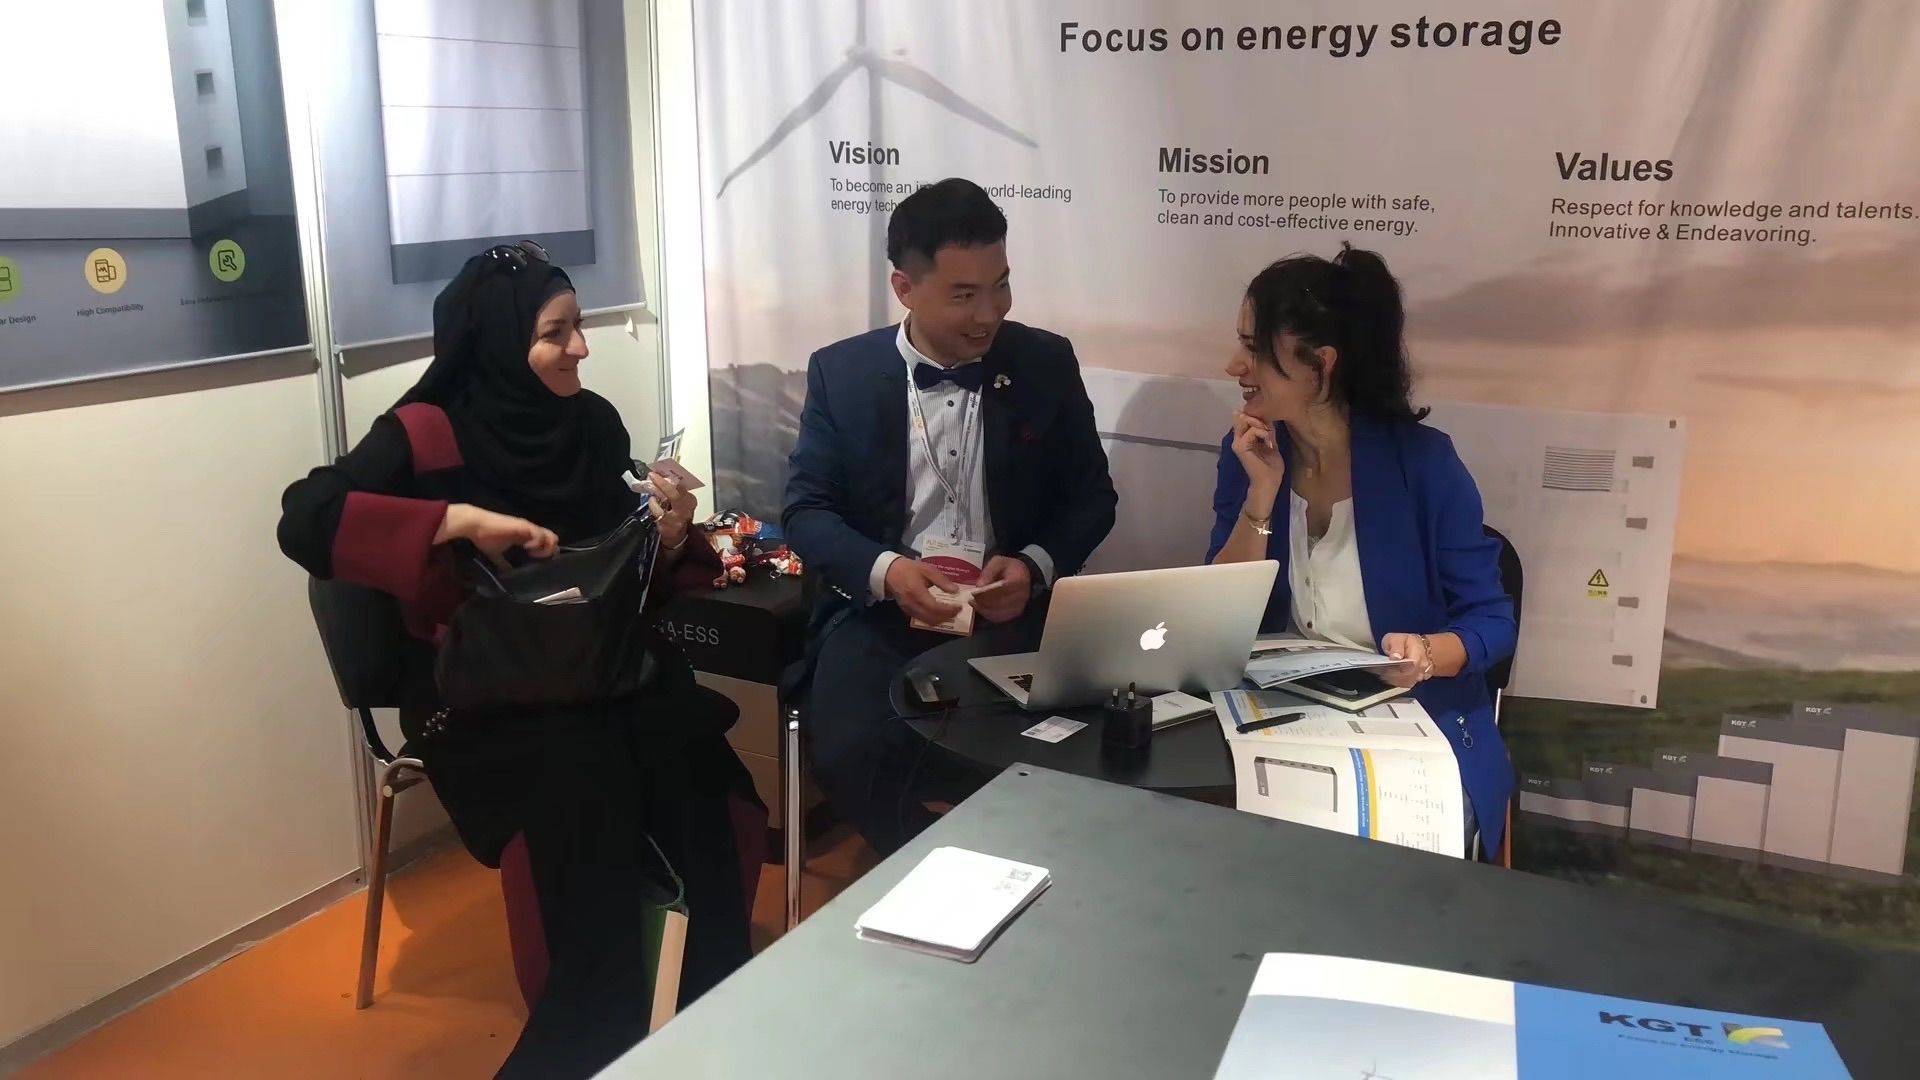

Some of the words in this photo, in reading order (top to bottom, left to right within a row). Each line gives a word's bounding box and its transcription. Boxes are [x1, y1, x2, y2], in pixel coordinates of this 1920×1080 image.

[1060, 21, 1168, 53] Focus
[1180, 24, 1225, 50] on
[1236, 23, 1379, 58] energy
[1389, 15, 1563, 56] storage
[829, 140, 900, 166] Vision
[1158, 147, 1270, 175] Mission
[1555, 152, 1674, 182] Values
[830, 178, 843, 192] To
[846, 178, 893, 194] become
[896, 183, 912, 194] an
[831, 199, 872, 214] energy
[1158, 188, 1176, 204] To
[1180, 190, 1240, 208] provide
[1243, 192, 1284, 207] more
[1289, 194, 1347, 211] people
[1352, 194, 1387, 210] with
[1391, 194, 1435, 213] safe,
[1551, 198, 1633, 218] Respect
[1638, 200, 1665, 216] for
[1670, 200, 1783, 222] knowledge
[1788, 201, 1830, 218] and
[1836, 202, 1919, 219] talents.
[1157, 210, 1199, 225] clean
[1203, 211, 1233, 226] and
[1237, 212, 1349, 230] cost-effective
[1353, 219, 1418, 236] energy.
[1550, 221, 1651, 240] Innovative
[1656, 223, 1670, 240] &
[1676, 223, 1817, 247] Endeavoring.
[8, 314, 37, 325] Design
[77, 308, 95, 317] High
[96, 303, 144, 316] Compatibility
[1598, 1011, 1713, 1037] KGT
